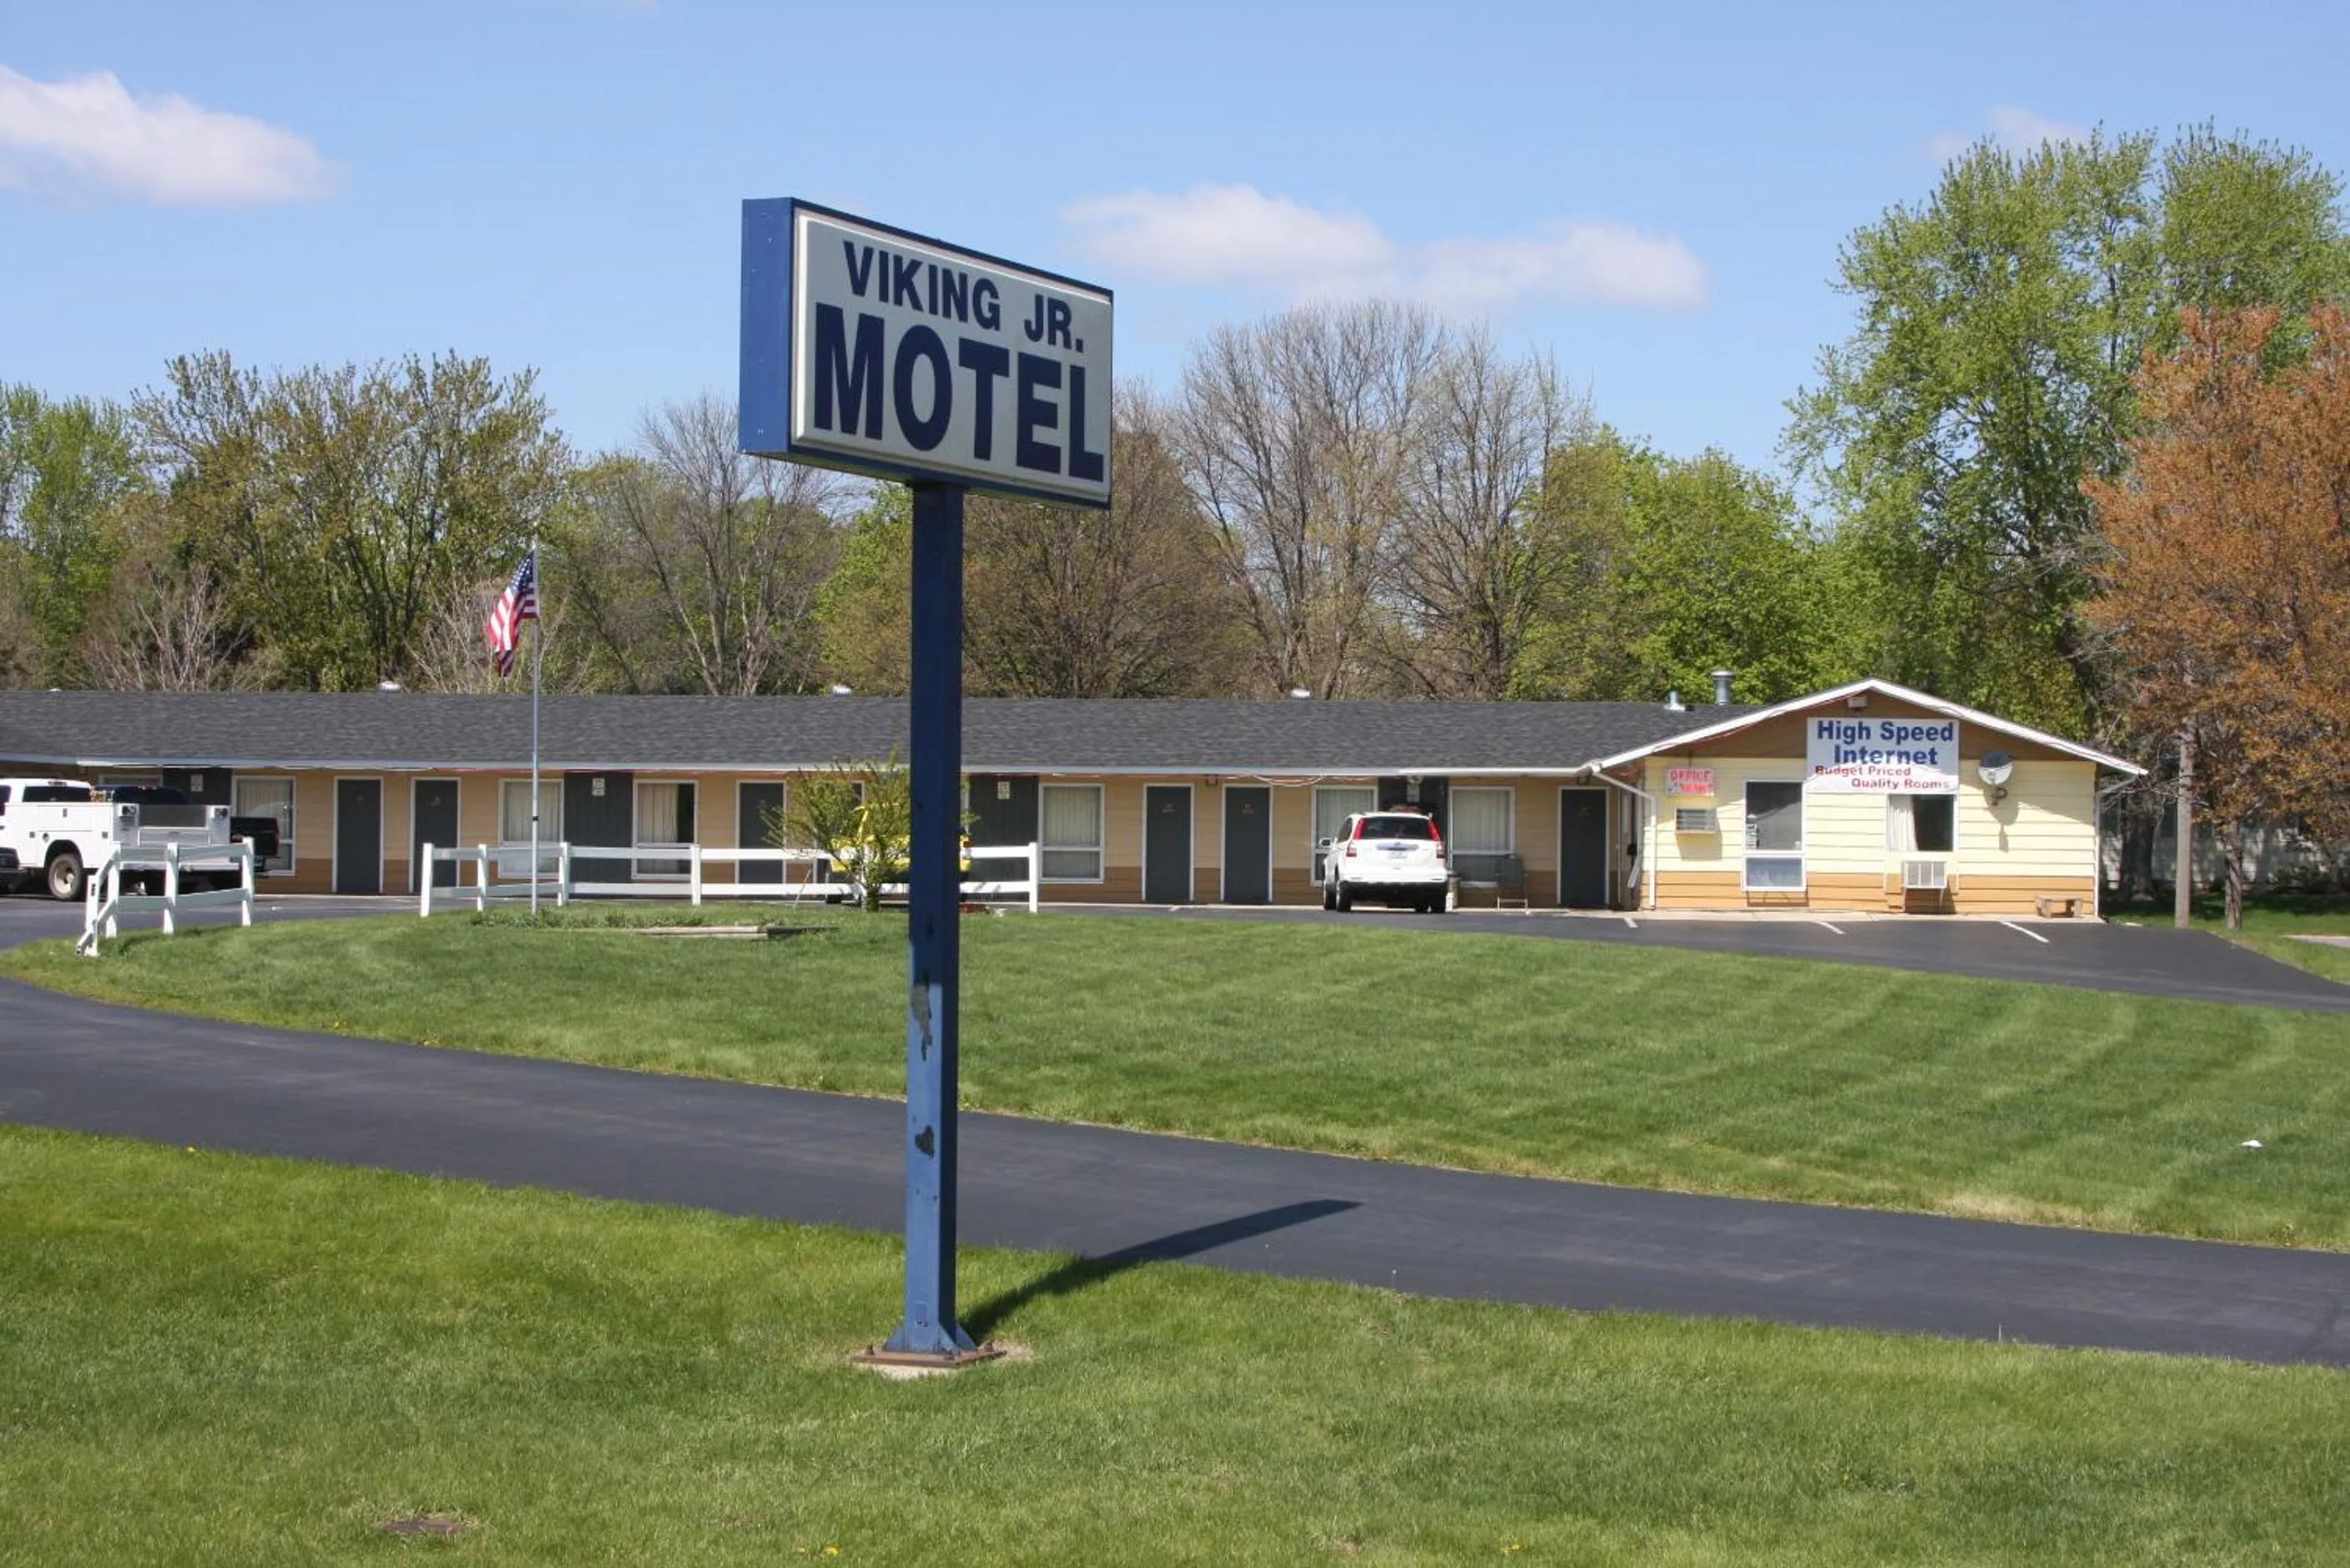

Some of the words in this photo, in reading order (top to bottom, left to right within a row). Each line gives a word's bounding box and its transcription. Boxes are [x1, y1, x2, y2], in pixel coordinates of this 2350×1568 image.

[844, 241, 1000, 331] VIKING
[1024, 294, 1083, 352] JR.
[814, 302, 1103, 481] MOTEL
[1817, 720, 1871, 745] High
[1880, 721, 1954, 745] Speed
[1834, 745, 1939, 765] Internet
[1815, 765, 1863, 777] Budget
[1868, 766, 1912, 777] Priced
[1851, 778, 1899, 789] Quality
[1904, 779, 1949, 789] Rooms
